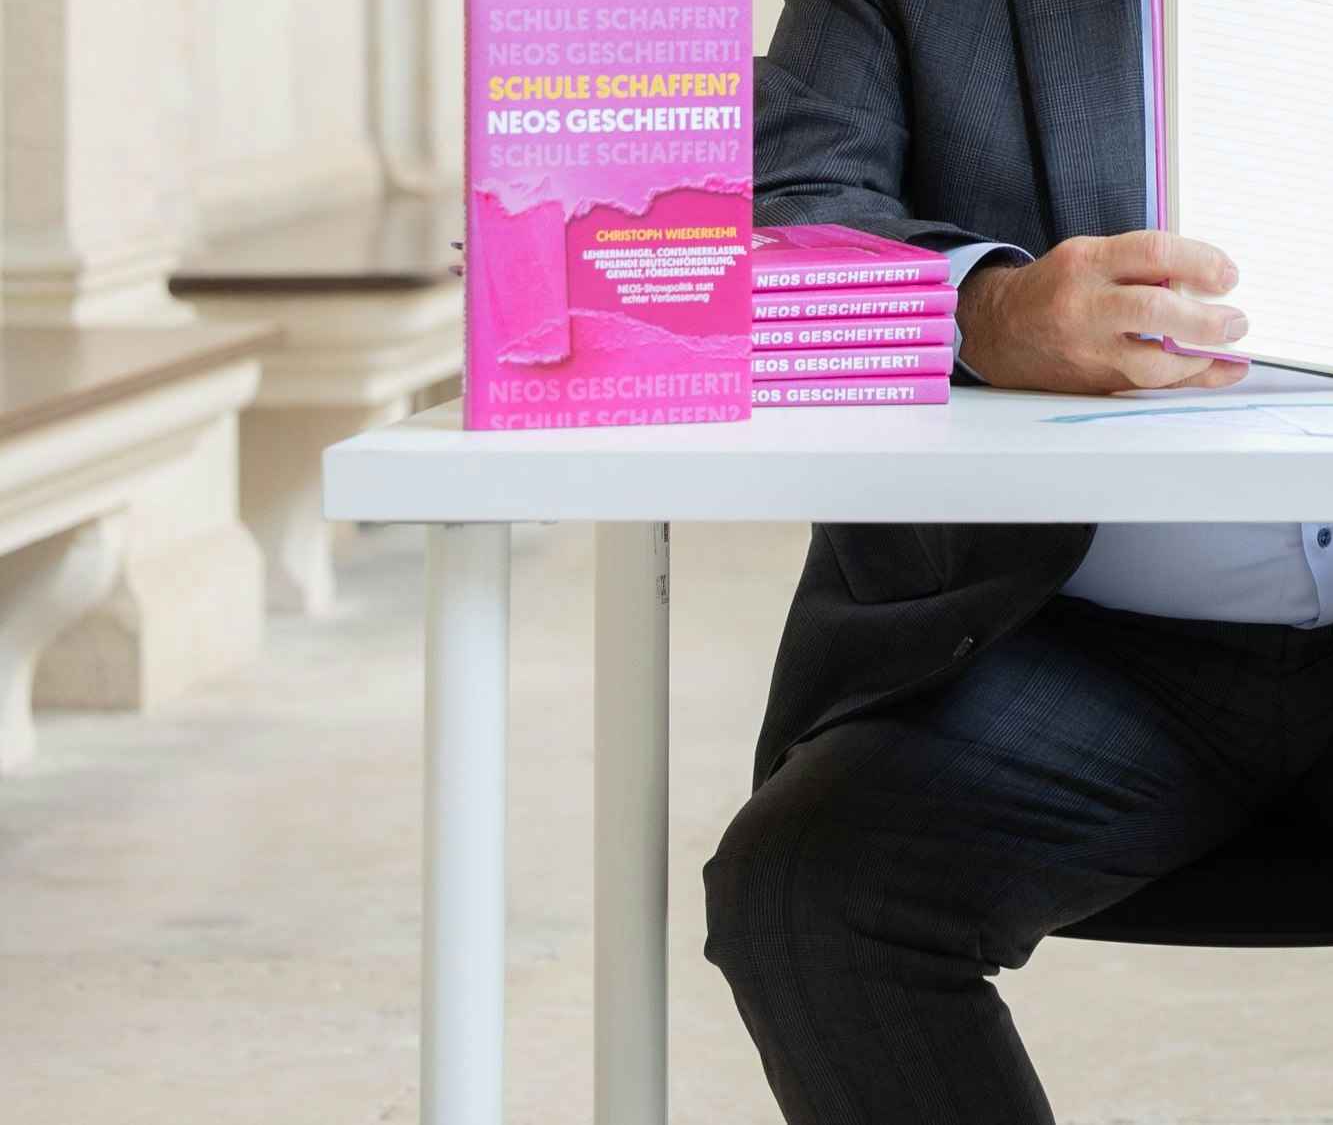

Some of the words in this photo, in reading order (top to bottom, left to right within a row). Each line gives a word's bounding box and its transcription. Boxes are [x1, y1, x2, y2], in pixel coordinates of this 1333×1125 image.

[490, 8, 589, 32] SCHULE
[596, 6, 740, 30] SCHAFFEN?
[488, 42, 560, 66] NEOS
[566, 40, 741, 64] GESCHEITERT!
[488, 76, 590, 100] SCHULE
[596, 73, 741, 99] SCHAFFEN?
[487, 110, 561, 134] NEOS
[566, 106, 741, 133] GESCHEITERT!
[490, 143, 590, 168] SCHULE
[596, 139, 740, 166] SCHAFFEN?
[596, 229, 662, 242] CHRISTOPH
[665, 227, 737, 240] WIEDERKEHR
[583, 249, 656, 260] LEHRERMANGEL,
[657, 246, 747, 257] CONTAINERKLASSEN,
[595, 259, 638, 269] FEHLENDE
[639, 256, 736, 269] DEUTSCHFÖRDERUNG,
[606, 269, 644, 279] GEWALT,
[646, 266, 725, 278] FÖRDERSKANDALE
[757, 274, 801, 288] NEOS
[805, 268, 920, 285] GESCHEITERT!
[617, 283, 694, 294] NEOS-Showpolitik
[696, 282, 714, 291] statt
[622, 295, 649, 304] echter
[651, 293, 710, 304] Verbesserung
[755, 305, 800, 319] NEOS
[805, 300, 925, 317] GESCHEITERT!
[752, 331, 793, 345] NEOS
[798, 327, 921, 344] GESCHEITERT!
[794, 355, 919, 372] GESCHEITERT!
[488, 379, 560, 404] NEOS
[567, 372, 741, 401] GESCHEITERT!
[752, 389, 781, 402] EOS
[786, 387, 915, 402] GESCHEITERT!
